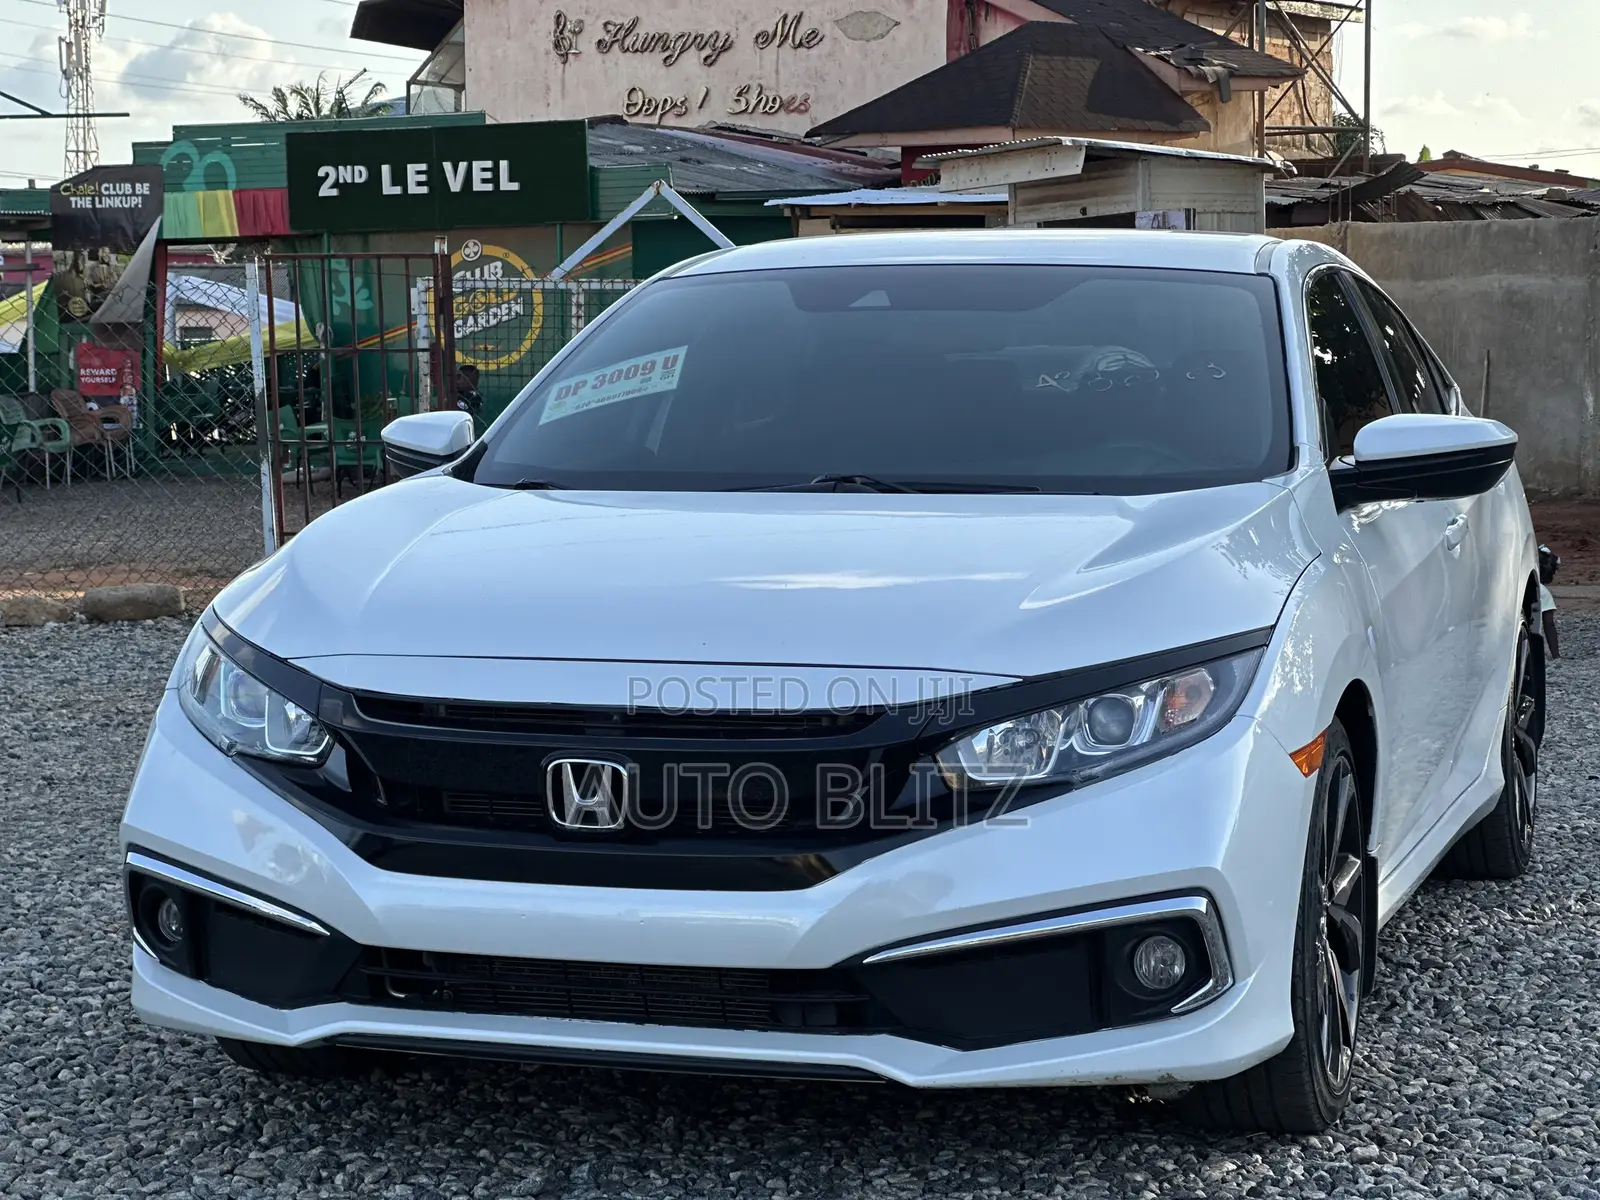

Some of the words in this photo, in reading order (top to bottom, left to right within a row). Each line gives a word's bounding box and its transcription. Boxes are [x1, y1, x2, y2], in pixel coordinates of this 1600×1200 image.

[595, 14, 735, 67] Hungry
[753, 10, 825, 51] Me
[622, 85, 688, 126] Oops
[59, 181, 99, 196] Chale!
[100, 183, 132, 195] CLUB
[135, 183, 150, 195] BE
[317, 164, 369, 197] 2ND
[69, 196, 93, 209] THE
[94, 196, 143, 209] LINKUP!
[453, 296, 524, 339] GARDEN
[80, 368, 118, 376] REWARD
[80, 376, 116, 384] YOURSELF
[554, 379, 588, 401] DP
[590, 360, 658, 390] 3009
